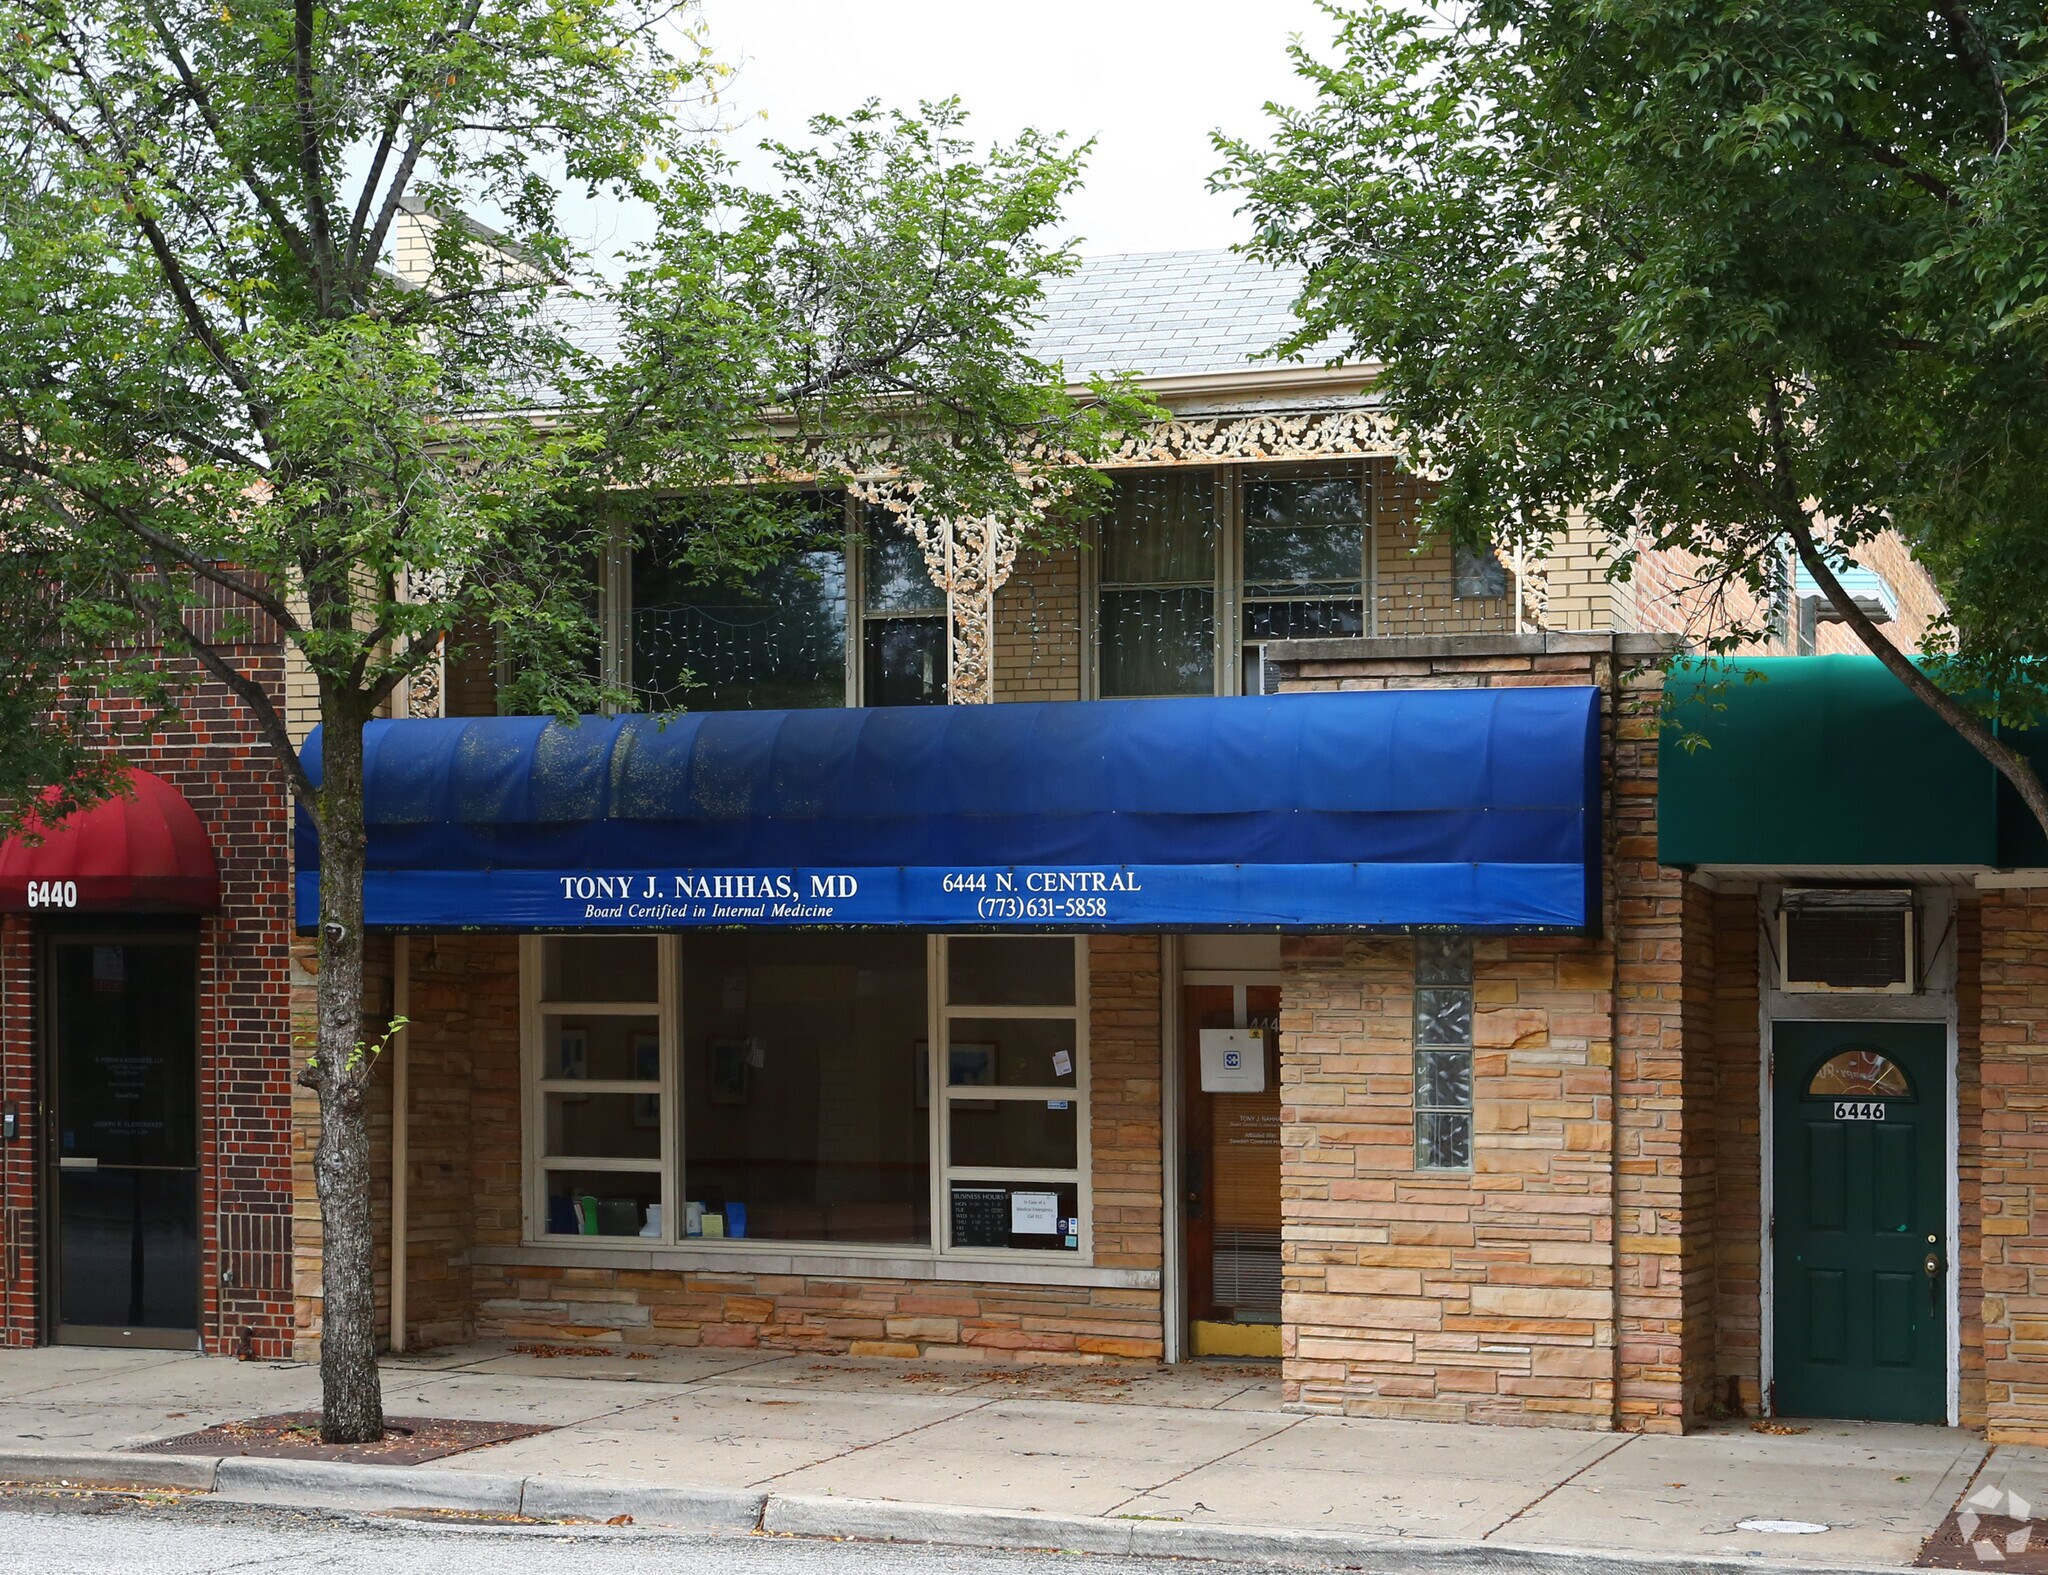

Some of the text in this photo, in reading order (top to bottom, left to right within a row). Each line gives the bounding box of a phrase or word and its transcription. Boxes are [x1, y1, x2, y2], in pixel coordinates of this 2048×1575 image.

[560, 875, 858, 902] TONY J. NAHHAS, MD
[942, 871, 1142, 893] 6444 N. CENTRAL
[27, 880, 77, 908] 6440
[584, 903, 834, 920] Board Certified in Internal Medicine
[977, 895, 1107, 919] (773)631-5858
[1836, 1103, 1884, 1119] 6446
